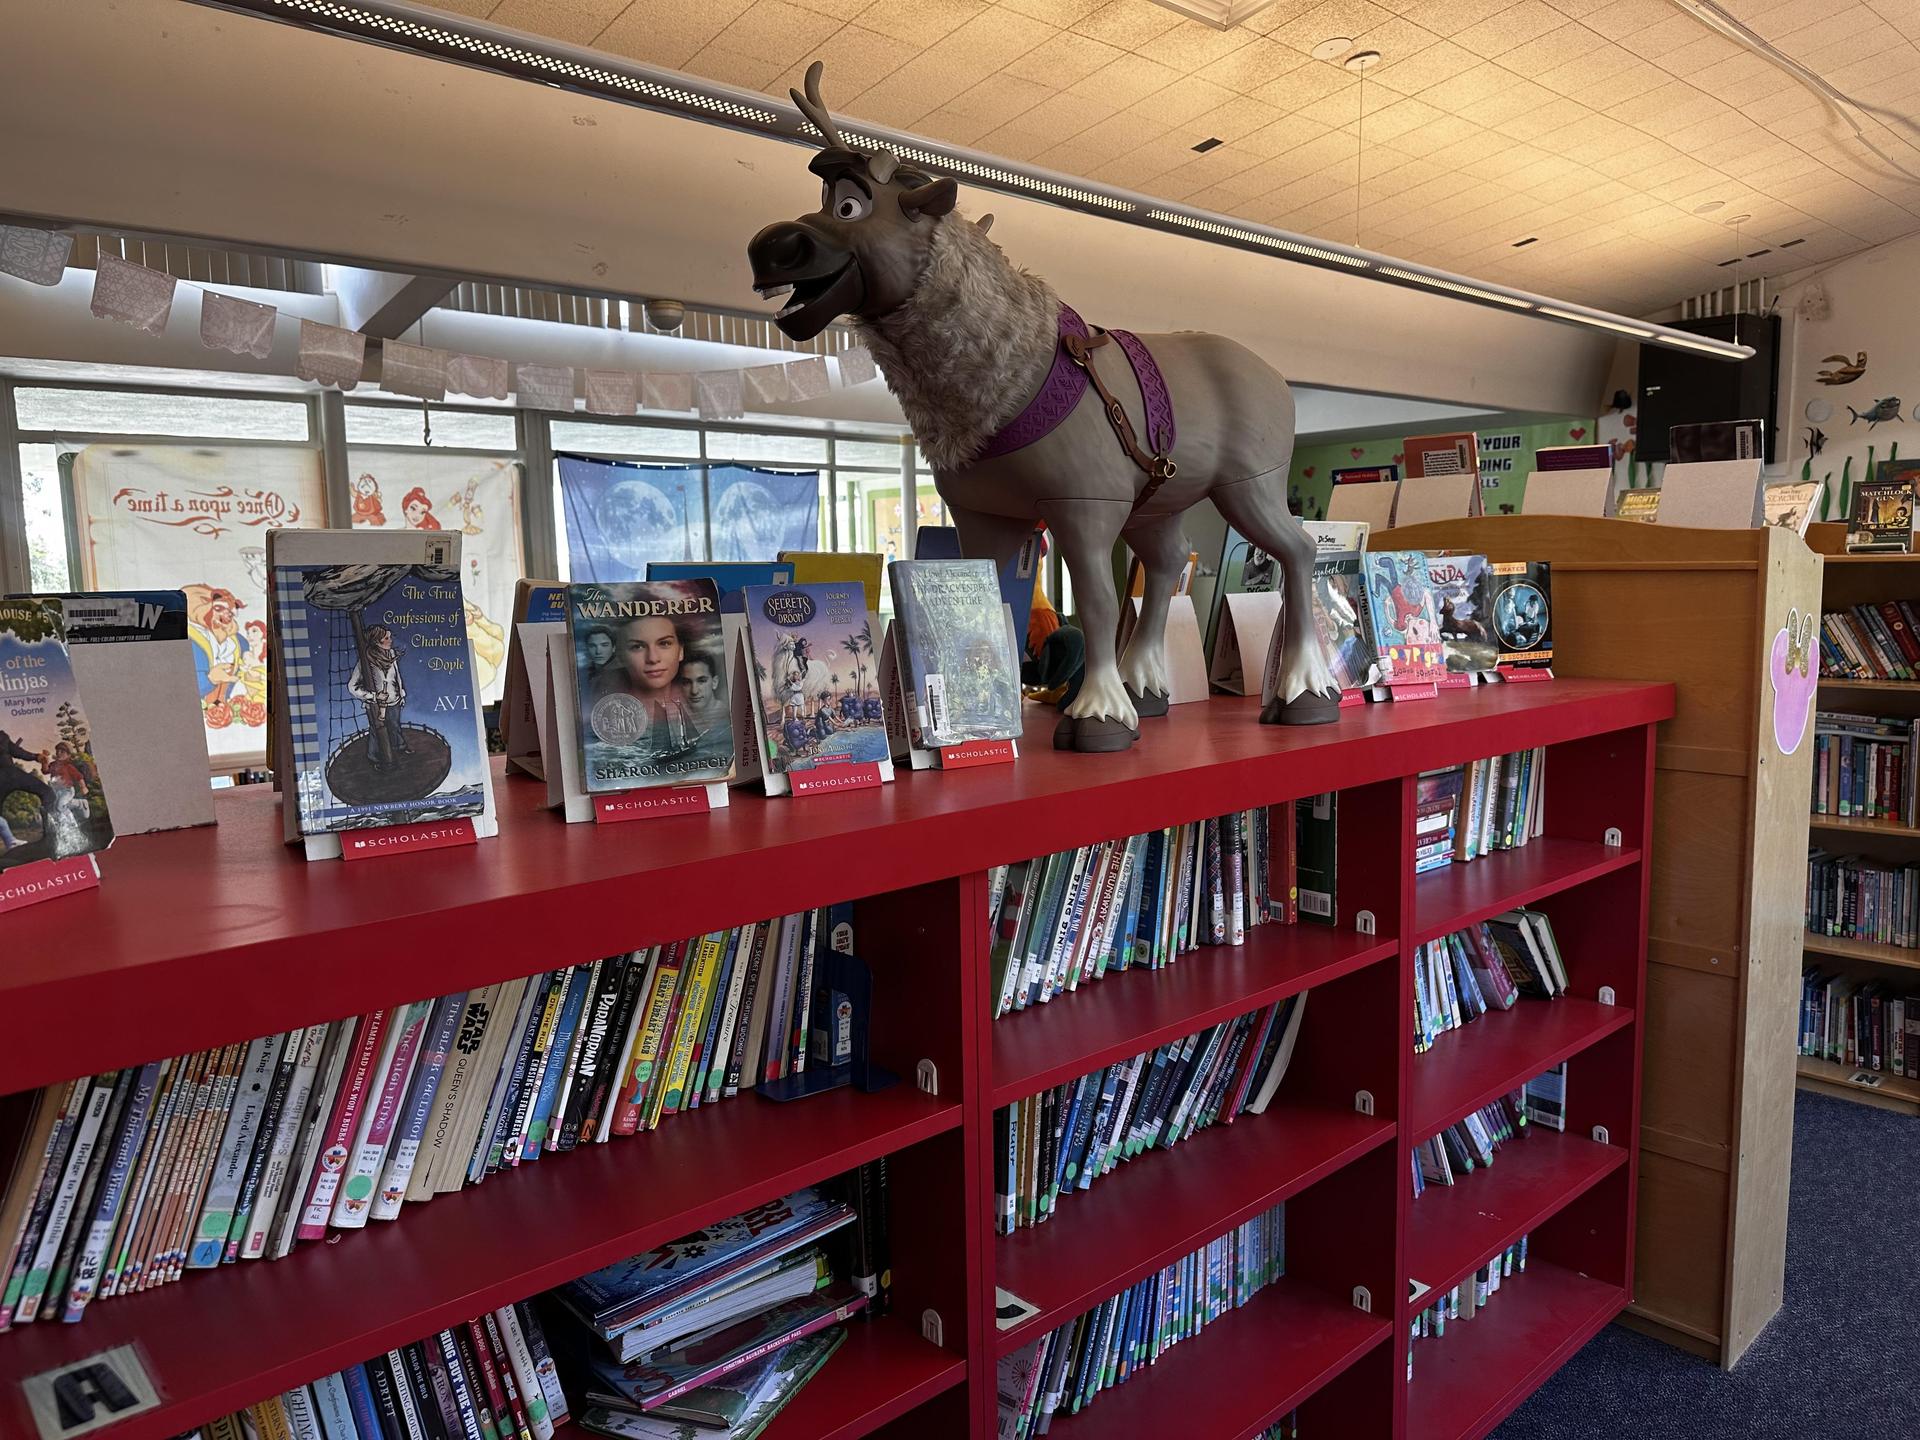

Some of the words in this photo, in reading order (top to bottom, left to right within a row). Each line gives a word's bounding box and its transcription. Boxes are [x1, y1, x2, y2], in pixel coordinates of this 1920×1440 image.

[1483, 436, 1521, 450] YOUR
[1627, 494, 1660, 504] MIGHTY
[401, 584, 425, 600] The
[428, 585, 458, 600] True
[584, 587, 606, 601] The
[577, 597, 715, 619] WANDERER
[767, 595, 811, 617] SECRETS
[383, 609, 446, 629] Confessions
[448, 608, 461, 627] of
[778, 612, 805, 624] DROON
[411, 634, 462, 648] Charlotte
[6, 656, 21, 670] of
[22, 655, 46, 668] the
[427, 657, 465, 675] Doyle
[0, 672, 49, 694] Ninjas
[4, 698, 26, 708] Mary
[26, 696, 47, 706] Pope
[434, 695, 469, 712] AVI
[1399, 691, 1435, 700] SCHOLASTIC
[11, 706, 45, 717] Osborne
[743, 718, 752, 737] Fold
[742, 744, 750, 768] STEP
[955, 748, 1008, 759] SCHOLASTIC
[595, 764, 660, 781] SHARON
[665, 757, 729, 775] CREECH
[808, 774, 873, 789] SCHOLASTIC
[373, 802, 407, 811] NEWBERY
[409, 800, 436, 808] HONOR
[437, 797, 458, 805] BOOK
[616, 795, 698, 810] SCHOLASTIC
[368, 828, 464, 847] SCHOLASTIC
[1110, 850, 1122, 871] THE
[0, 870, 87, 901] SCHOLASTIC
[1065, 873, 1080, 916] BEING
[756, 936, 765, 949] THE
[752, 950, 763, 971] SECRET
[656, 974, 670, 1001] GREAT
[549, 997, 556, 1009] ON
[741, 996, 752, 1023] FORTUNE
[456, 1002, 480, 1051] WARS
[464, 1002, 490, 1054] STAR
[544, 1010, 552, 1027] THE
[647, 1001, 661, 1036] LIBRARY
[724, 999, 739, 1042] Treasure
[364, 1020, 379, 1048] LAMAR'S
[537, 1028, 547, 1049] RUN
[579, 992, 618, 1077] PARANORMAN
[360, 1048, 371, 1064] BAD
[431, 1030, 451, 1070] BLACK
[641, 1036, 652, 1055] RACE
[256, 1054, 272, 1074] King
[526, 1058, 540, 1087] CHASING
[353, 1064, 368, 1090] PRANK
[447, 1058, 468, 1100] QUEEN'S
[1855, 1073, 1879, 1084] N
[133, 1083, 151, 1102] My
[350, 1090, 360, 1110] WON
[92, 1093, 107, 1118] PATERSON
[240, 1104, 256, 1128] Lloyd
[278, 1117, 297, 1155] School
[292, 1086, 309, 1118] Library
[433, 1102, 454, 1148] SHADOW
[511, 1099, 527, 1137] FALCONERS
[114, 1107, 145, 1169] Thirteenth
[72, 1143, 91, 1176] Bridge
[227, 1129, 246, 1180] Alexander
[67, 1179, 77, 1190] to
[102, 1171, 123, 1212] Winter
[48, 1192, 74, 1245] Terabithia
[203, 1245, 214, 1262] A
[722, 1357, 745, 1372] CHRISTINA
[767, 1336, 790, 1351] BACKSTAGE
[390, 1351, 399, 1368] THE
[395, 1368, 411, 1407] FIGHTING
[447, 1359, 464, 1383] BUT
[466, 1358, 483, 1403] EVERLASTING
[54, 1362, 140, 1430] A
[374, 1369, 396, 1417] ADRIFT
[455, 1384, 471, 1410] THE
[667, 1385, 686, 1399] GABRIEL
[463, 1409, 480, 1440] TRUT
